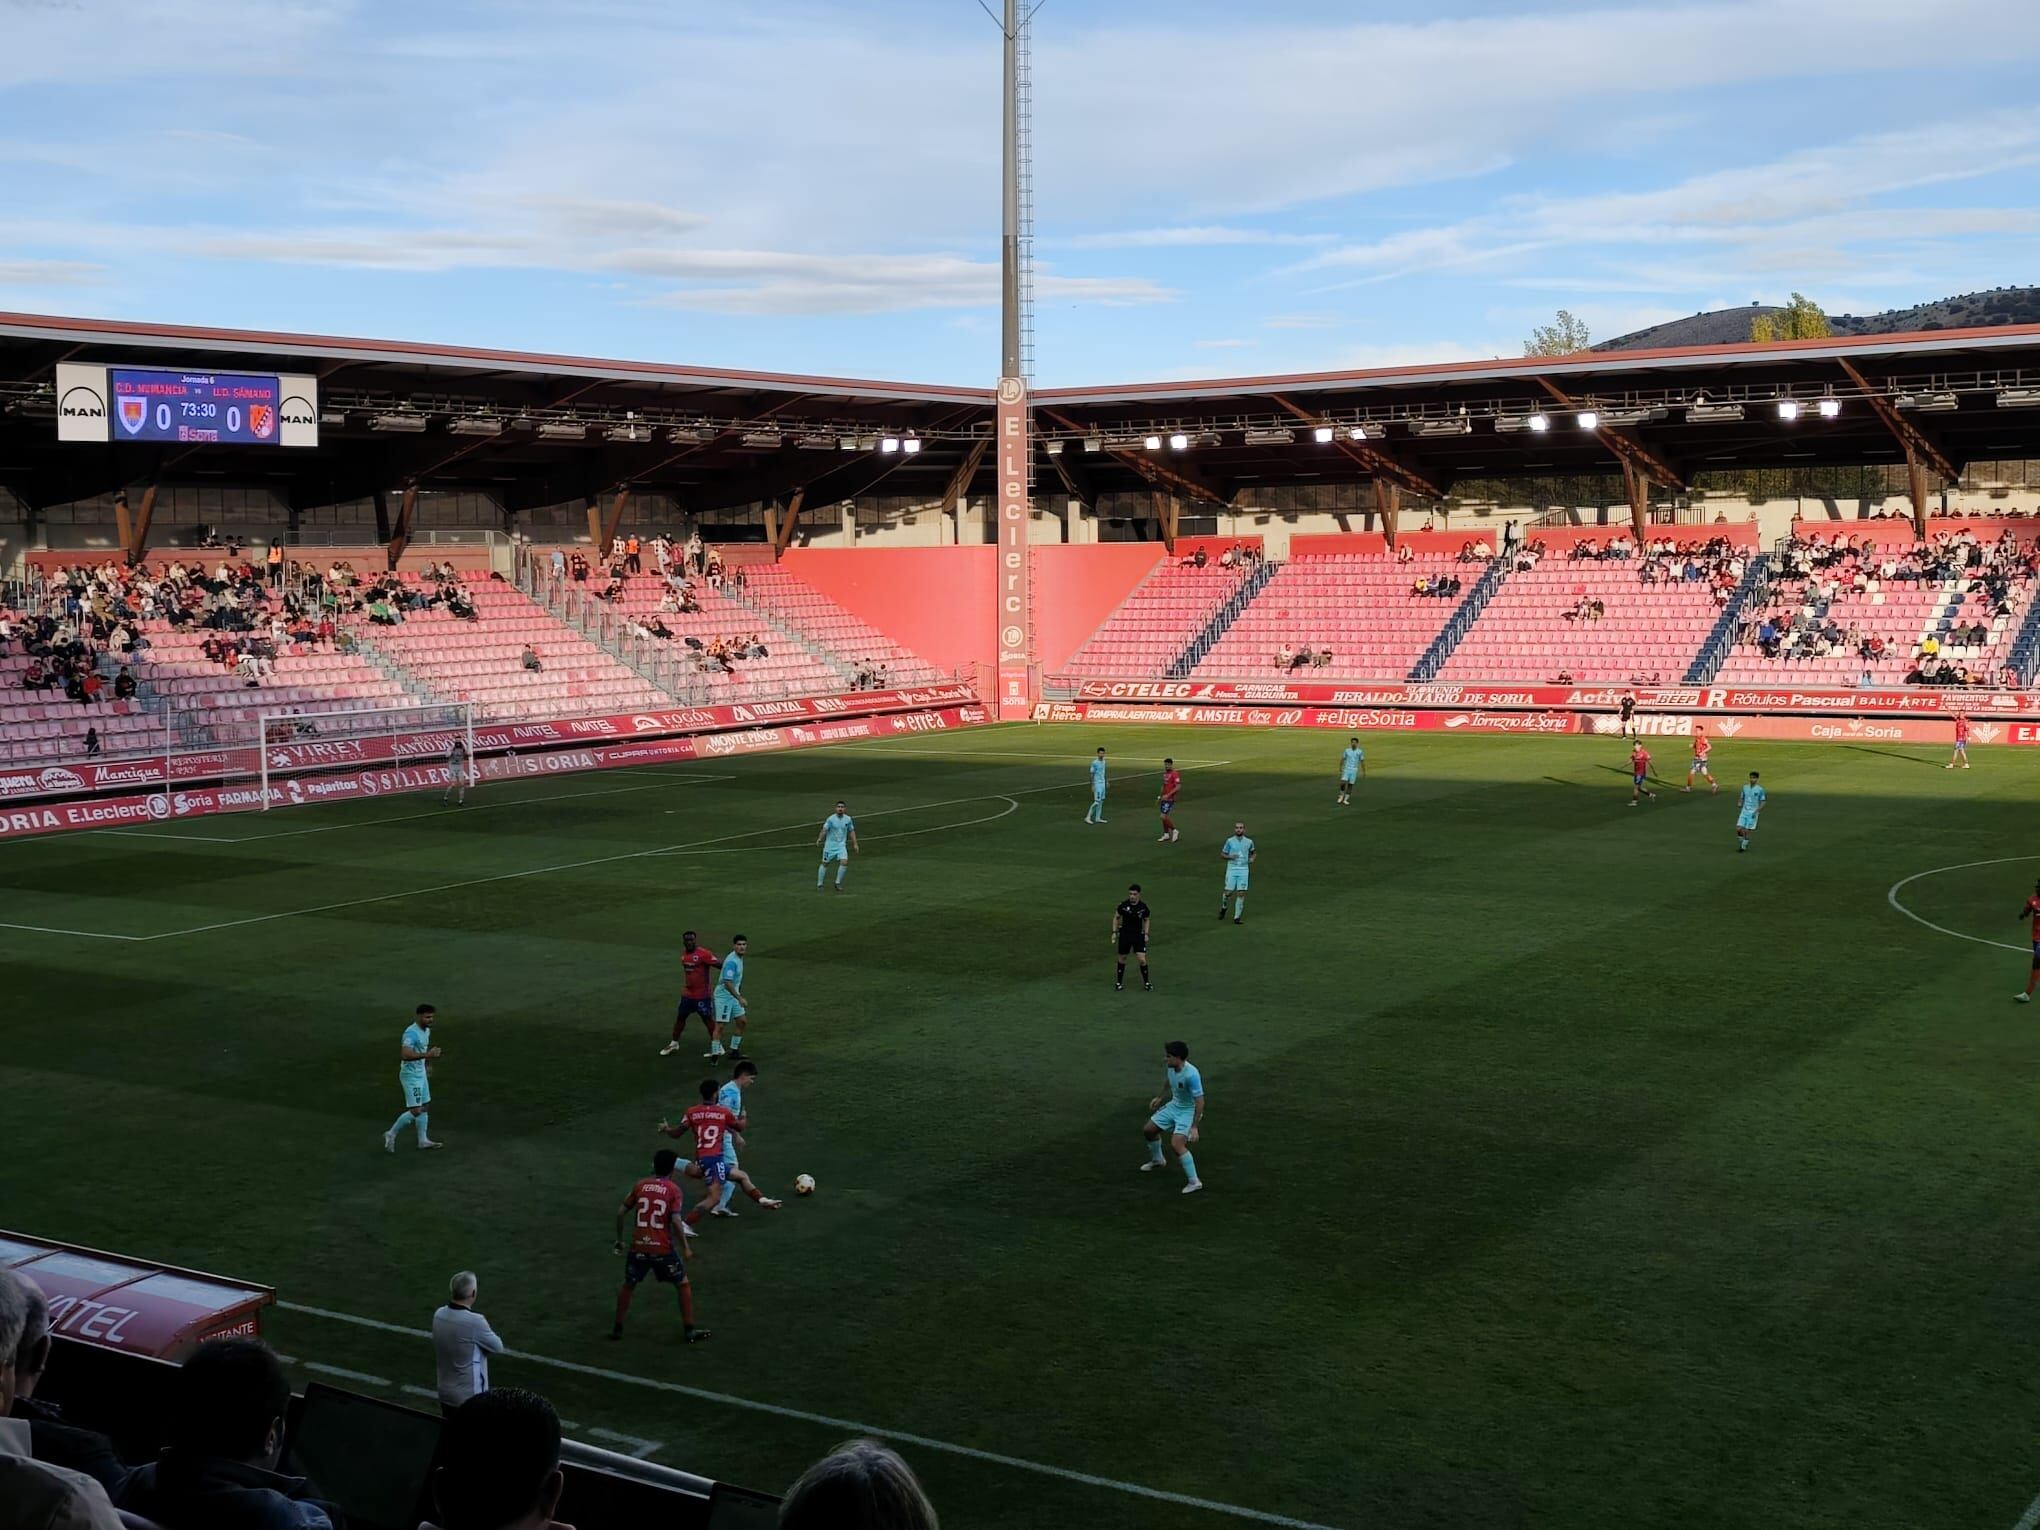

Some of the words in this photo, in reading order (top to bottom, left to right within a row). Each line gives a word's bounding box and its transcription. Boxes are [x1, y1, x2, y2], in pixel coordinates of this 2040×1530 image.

[181, 375, 209, 384] Jornada
[209, 376, 215, 384] 6
[138, 384, 188, 396] NUMANCIA
[63, 407, 102, 417] MAN
[156, 404, 171, 430] 0
[181, 402, 217, 417] 73:30
[226, 406, 241, 432] 0
[281, 415, 313, 424] MAN
[1111, 683, 1191, 697] CTELEC
[1235, 684, 1286, 692] CARNICAS
[1244, 691, 1298, 699] GIAQUINTA
[1463, 693, 1484, 704] DE
[1488, 694, 1534, 704] SORIA
[1657, 695, 1698, 704] BEEP
[1731, 693, 1787, 706] Rótulos
[1790, 694, 1856, 707] Pascual
[1941, 694, 1990, 702] PAVIMENTOS
[662, 709, 716, 725] FOGÓN
[1051, 711, 1082, 720] Herce
[1087, 709, 1173, 720] COMPRALAENTRADA
[1194, 709, 1243, 722] AMSTEL
[1316, 708, 1415, 729] #eligeSoria
[1521, 713, 1535, 728] de
[1535, 713, 1568, 728] Soria
[1811, 724, 1842, 738] Caja
[1865, 726, 1903, 738] Soria
[710, 733, 747, 747] MONTE
[390, 740, 435, 756] SANTO
[95, 766, 161, 783] Manrique
[307, 780, 358, 795] Pajaritos
[174, 794, 213, 815] Soria
[67, 804, 148, 824] E.Leclerc
[697, 1125, 719, 1149] 19
[637, 1197, 667, 1230] 22
